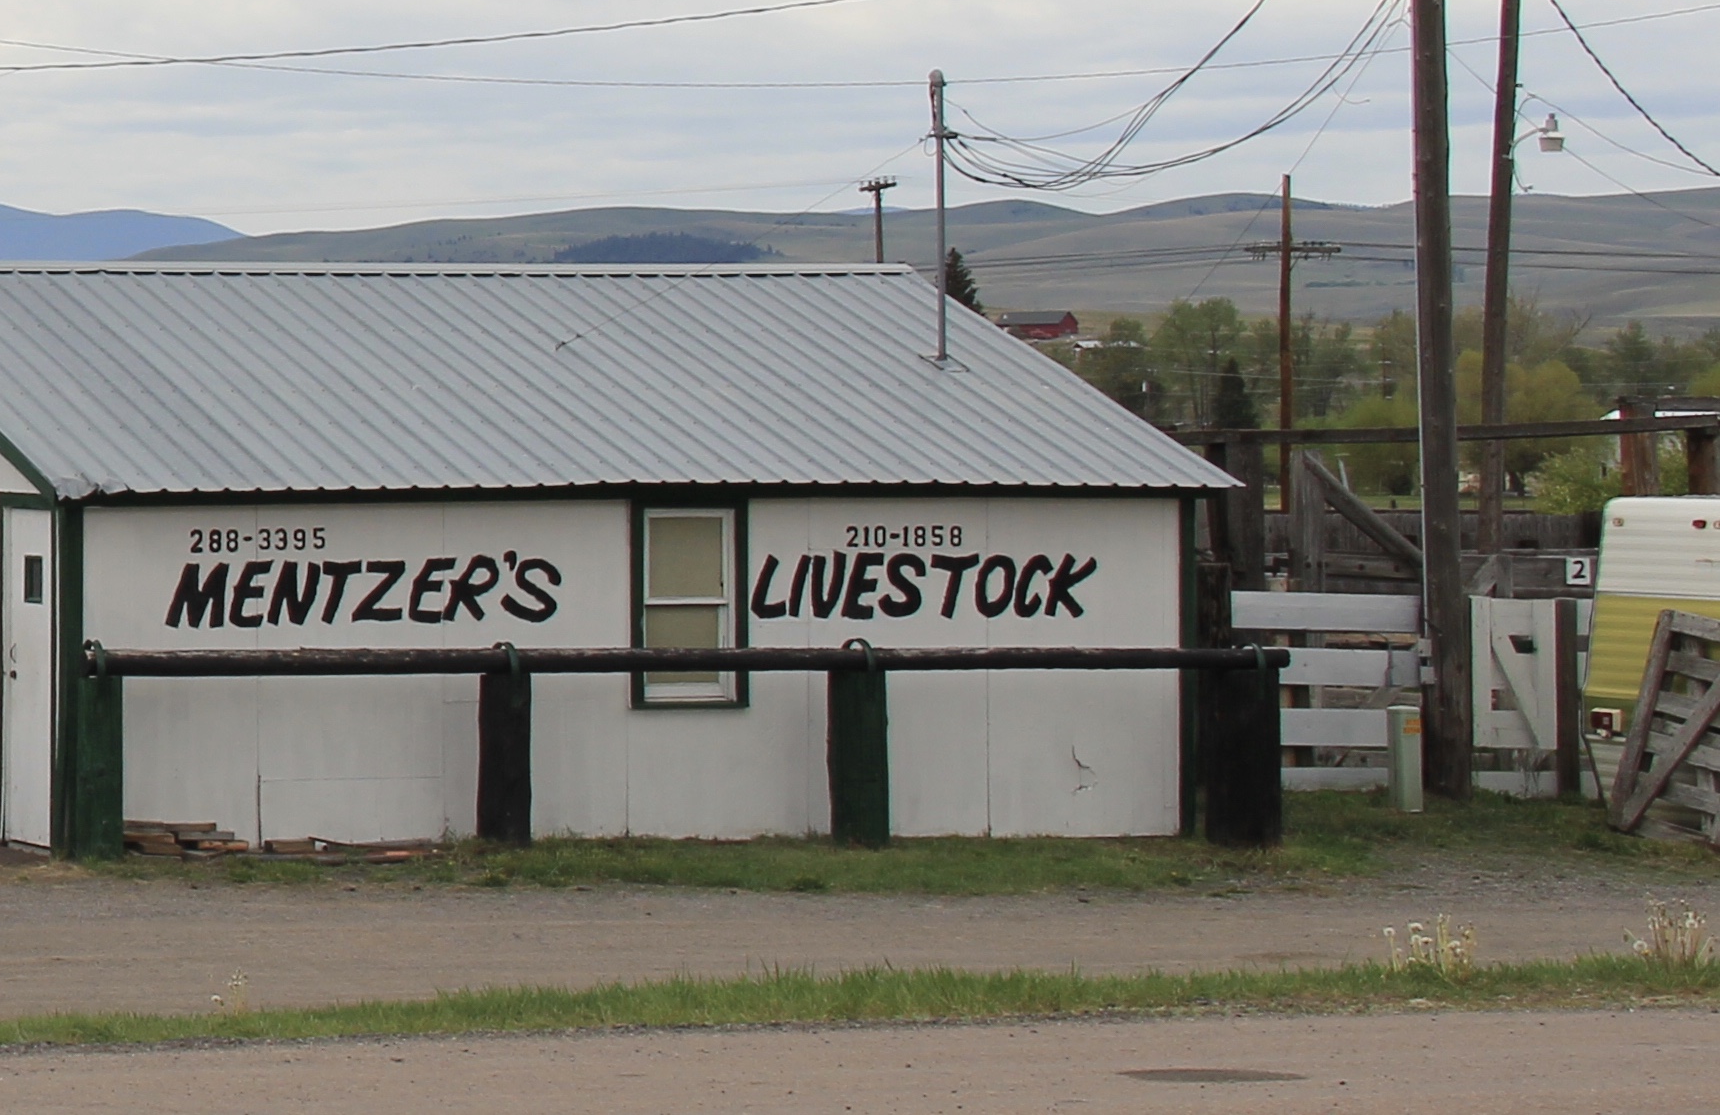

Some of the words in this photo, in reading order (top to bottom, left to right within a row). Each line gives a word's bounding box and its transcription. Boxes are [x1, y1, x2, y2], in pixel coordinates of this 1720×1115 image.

[190, 527, 326, 553] 288-3395
[846, 526, 962, 547] 210-1858
[1571, 560, 1586, 579] 2
[165, 550, 561, 628] MENTZER'S
[751, 551, 1097, 619] LIVESTOCK
